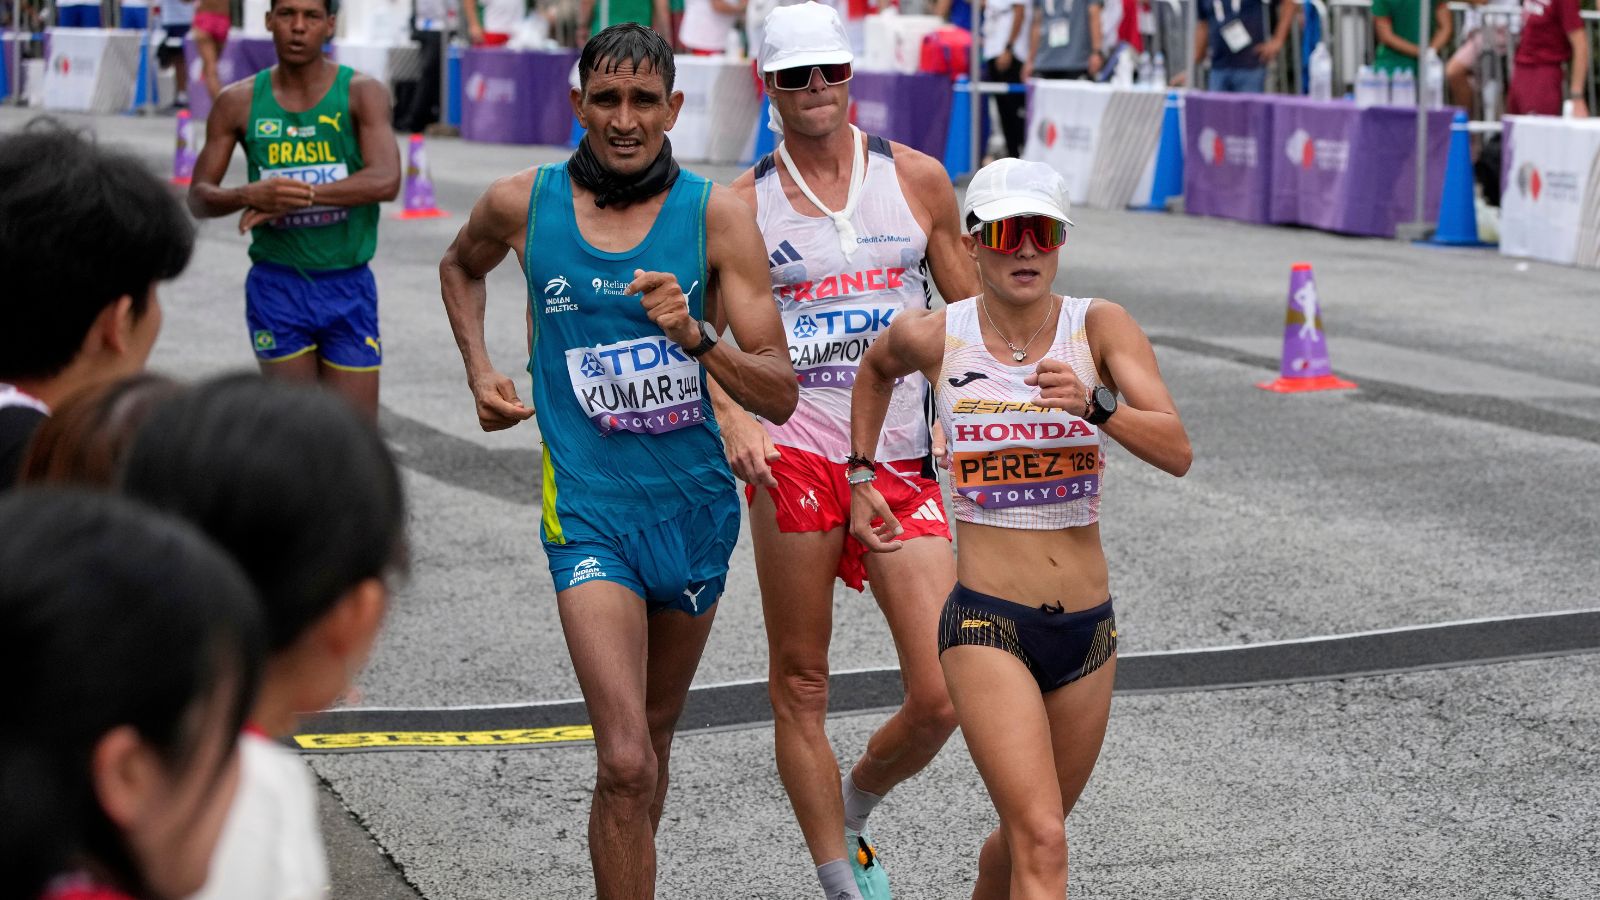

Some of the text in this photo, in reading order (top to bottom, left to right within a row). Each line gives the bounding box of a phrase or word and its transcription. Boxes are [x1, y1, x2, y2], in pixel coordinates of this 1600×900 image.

[268, 141, 336, 165] BRASIL
[281, 167, 337, 185] TDK
[856, 235, 911, 244] Crédit Mutuel
[603, 280, 630, 289] Relian
[780, 267, 906, 302] FRANCE
[546, 297, 570, 305] INDIAN
[815, 308, 895, 335] TDK
[598, 339, 688, 377] TDK
[581, 374, 699, 413] KUMAR 344
[953, 398, 1064, 414] ESPA
[954, 419, 1095, 442] HONDA
[960, 451, 1095, 484] PÉREZ 126
[569, 572, 607, 586] ATHLETICS
[573, 567, 600, 578] INDIAN
